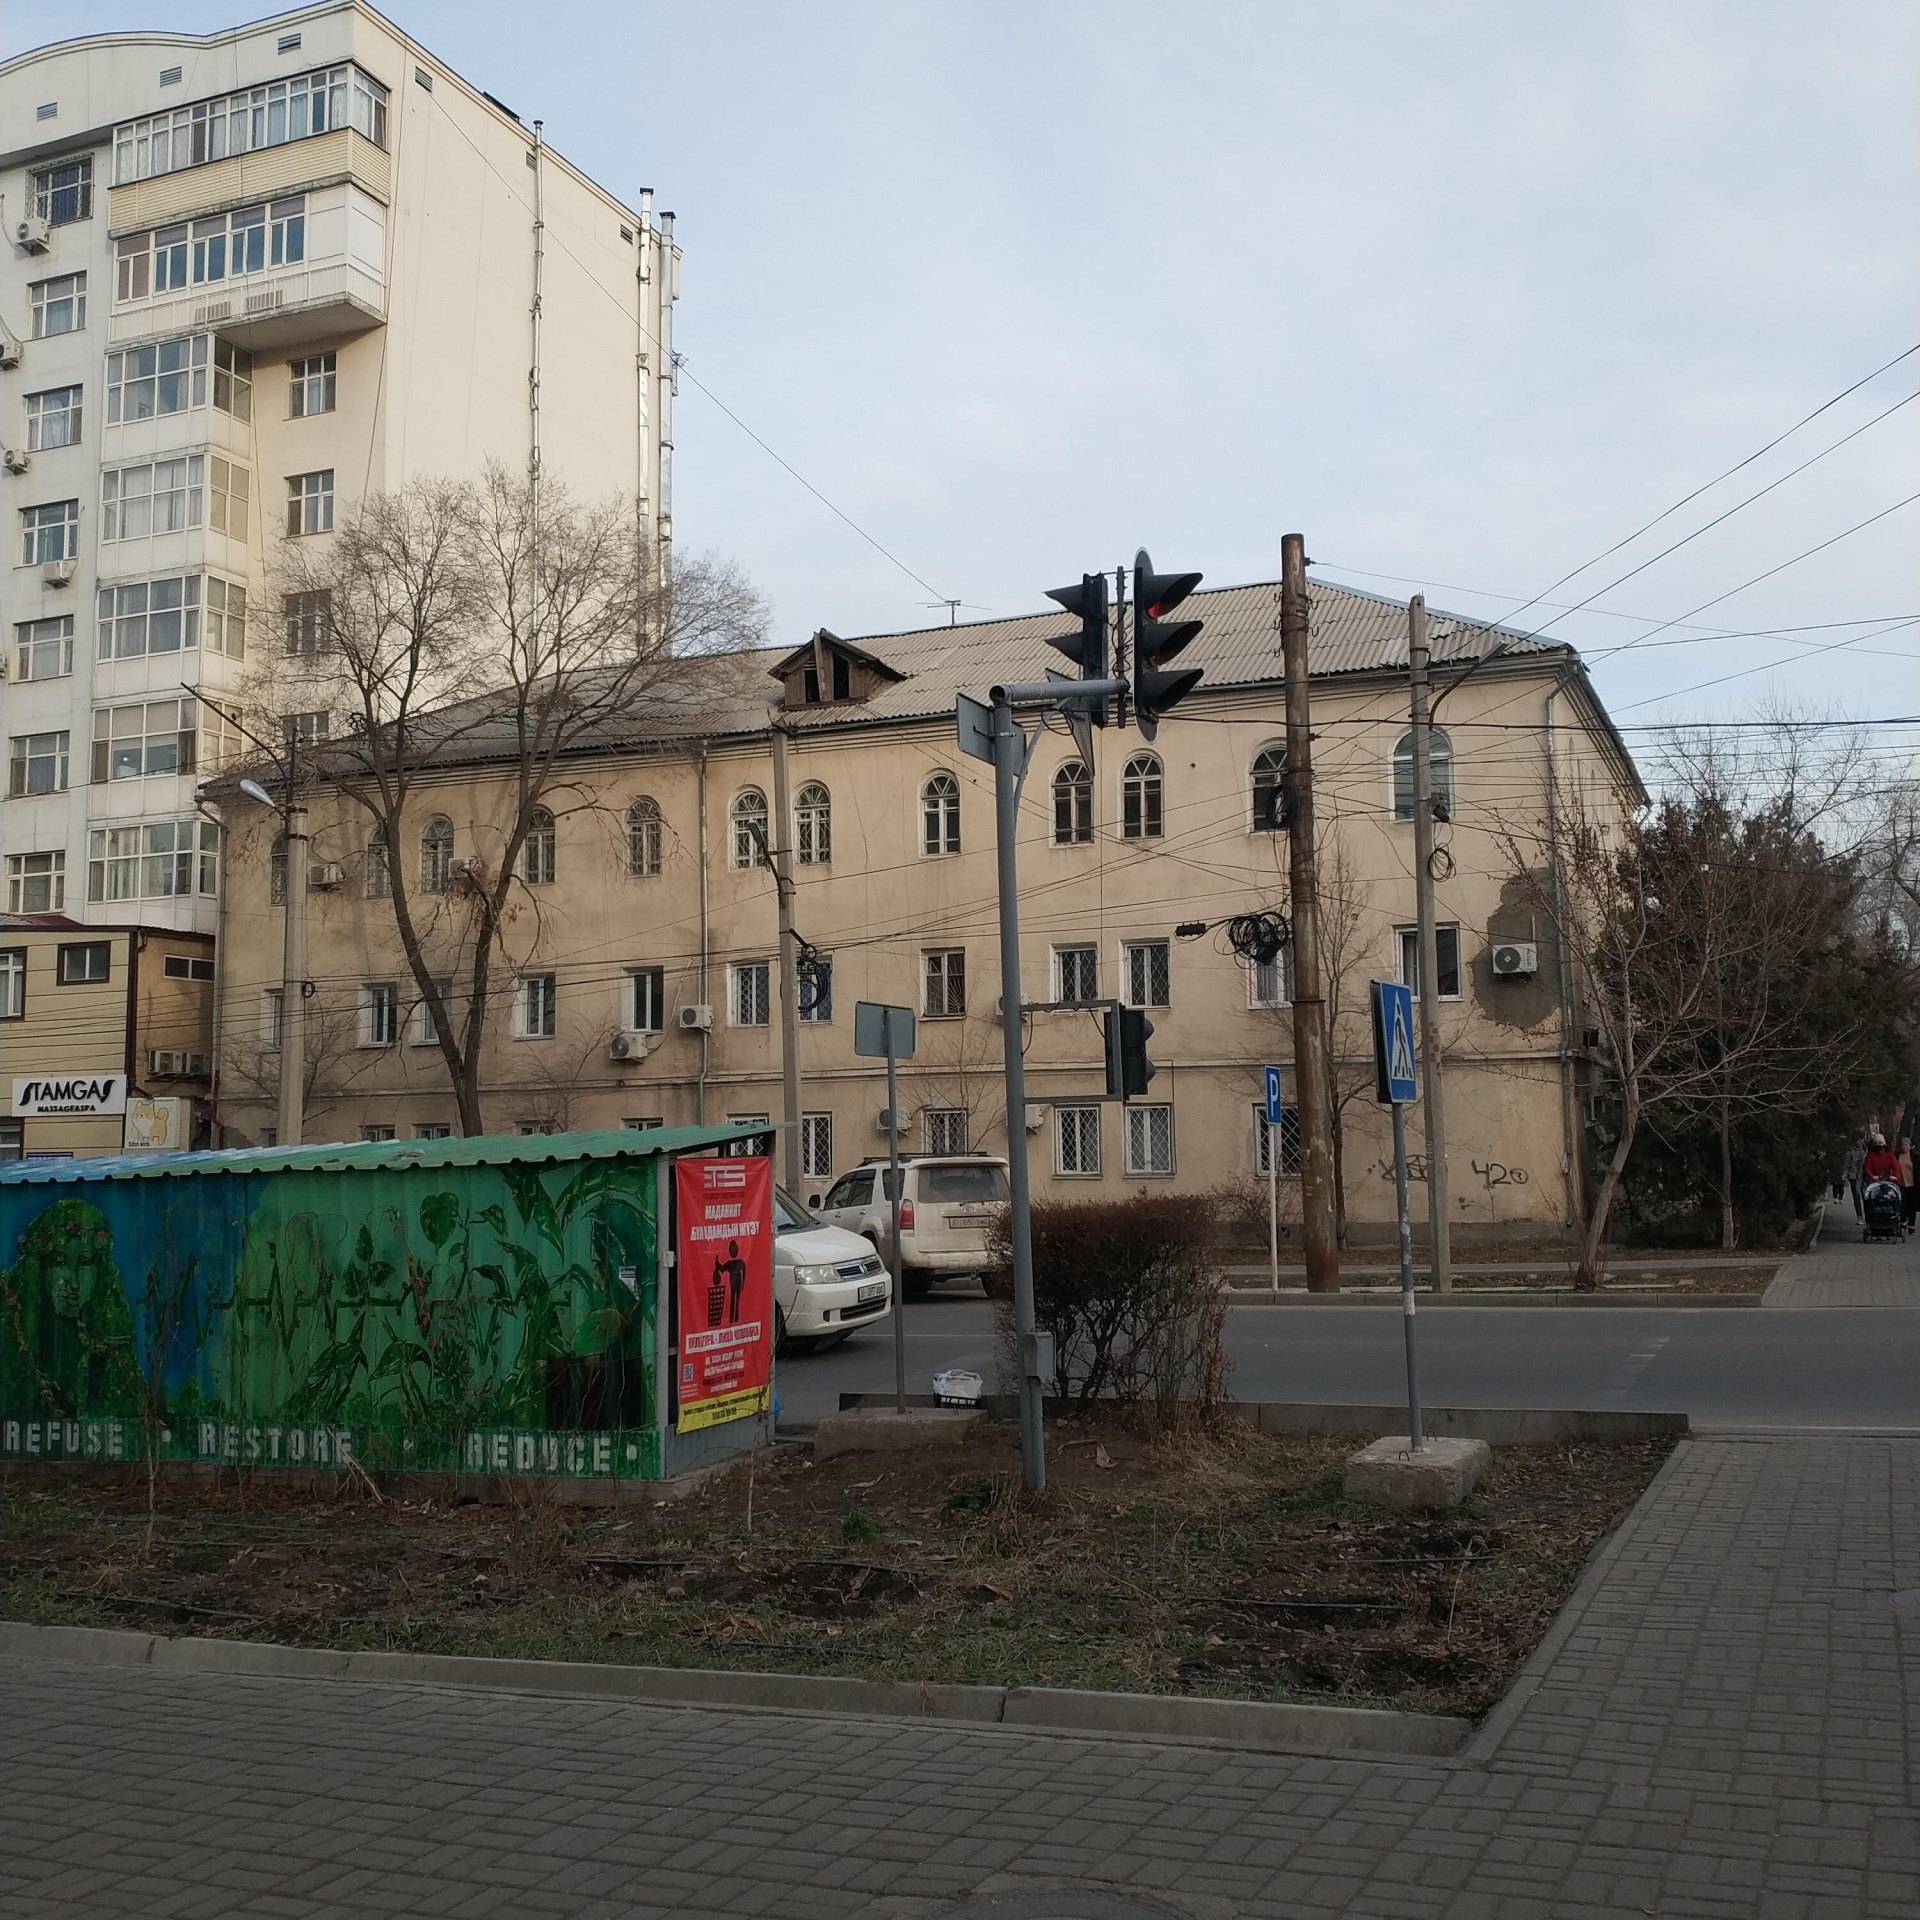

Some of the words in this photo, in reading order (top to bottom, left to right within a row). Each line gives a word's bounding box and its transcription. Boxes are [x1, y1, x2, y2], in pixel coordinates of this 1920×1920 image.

[37, 1104, 96, 1113] MASSAGE&SPA
[1269, 1073, 1279, 1118] P
[5, 1420, 123, 1456] REFUSE
[199, 1422, 352, 1463] RESTORE
[467, 1433, 611, 1472] REDUCE
